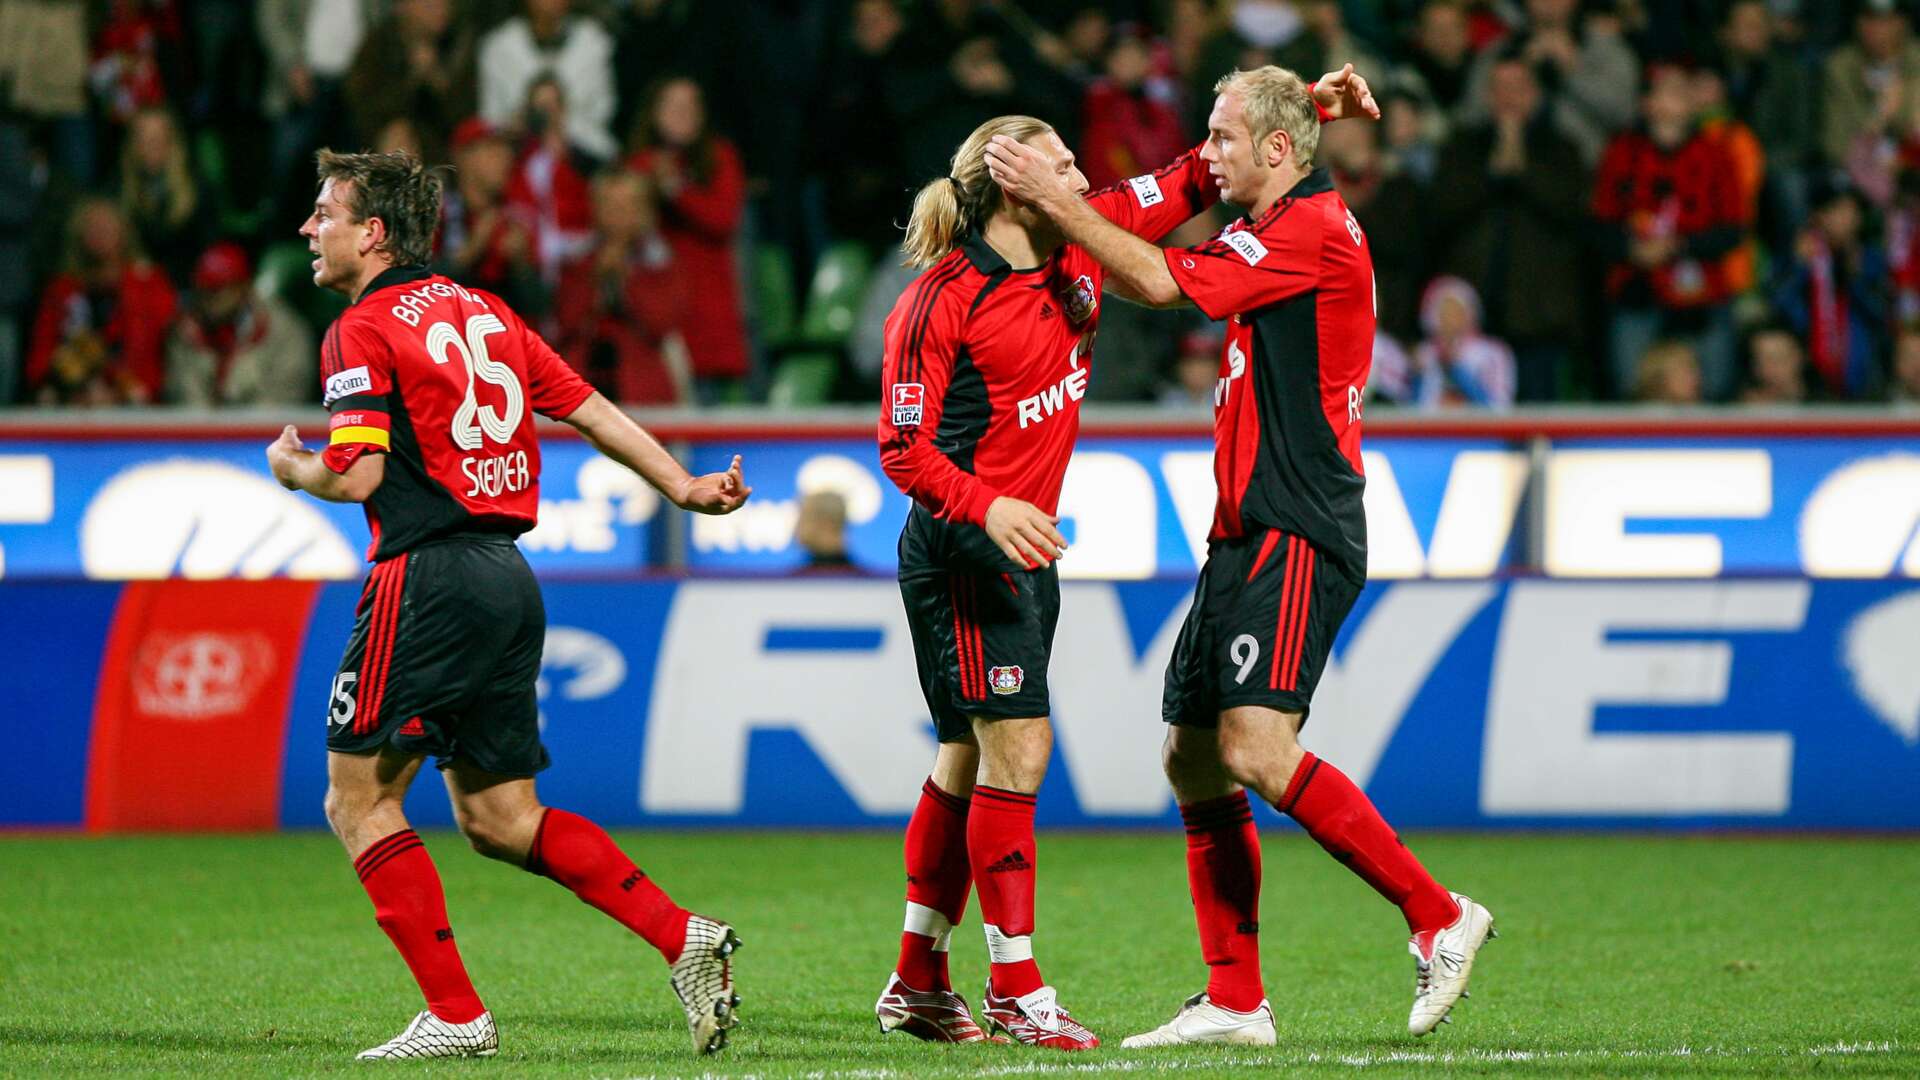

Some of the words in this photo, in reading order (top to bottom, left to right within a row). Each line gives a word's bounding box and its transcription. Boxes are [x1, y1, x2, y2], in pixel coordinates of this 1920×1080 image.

[425, 313, 524, 450] 25
[1016, 368, 1087, 429] RWE
[895, 413, 920, 423] LIGA
[1230, 634, 1260, 685] 9
[640, 580, 1812, 816] RWE
